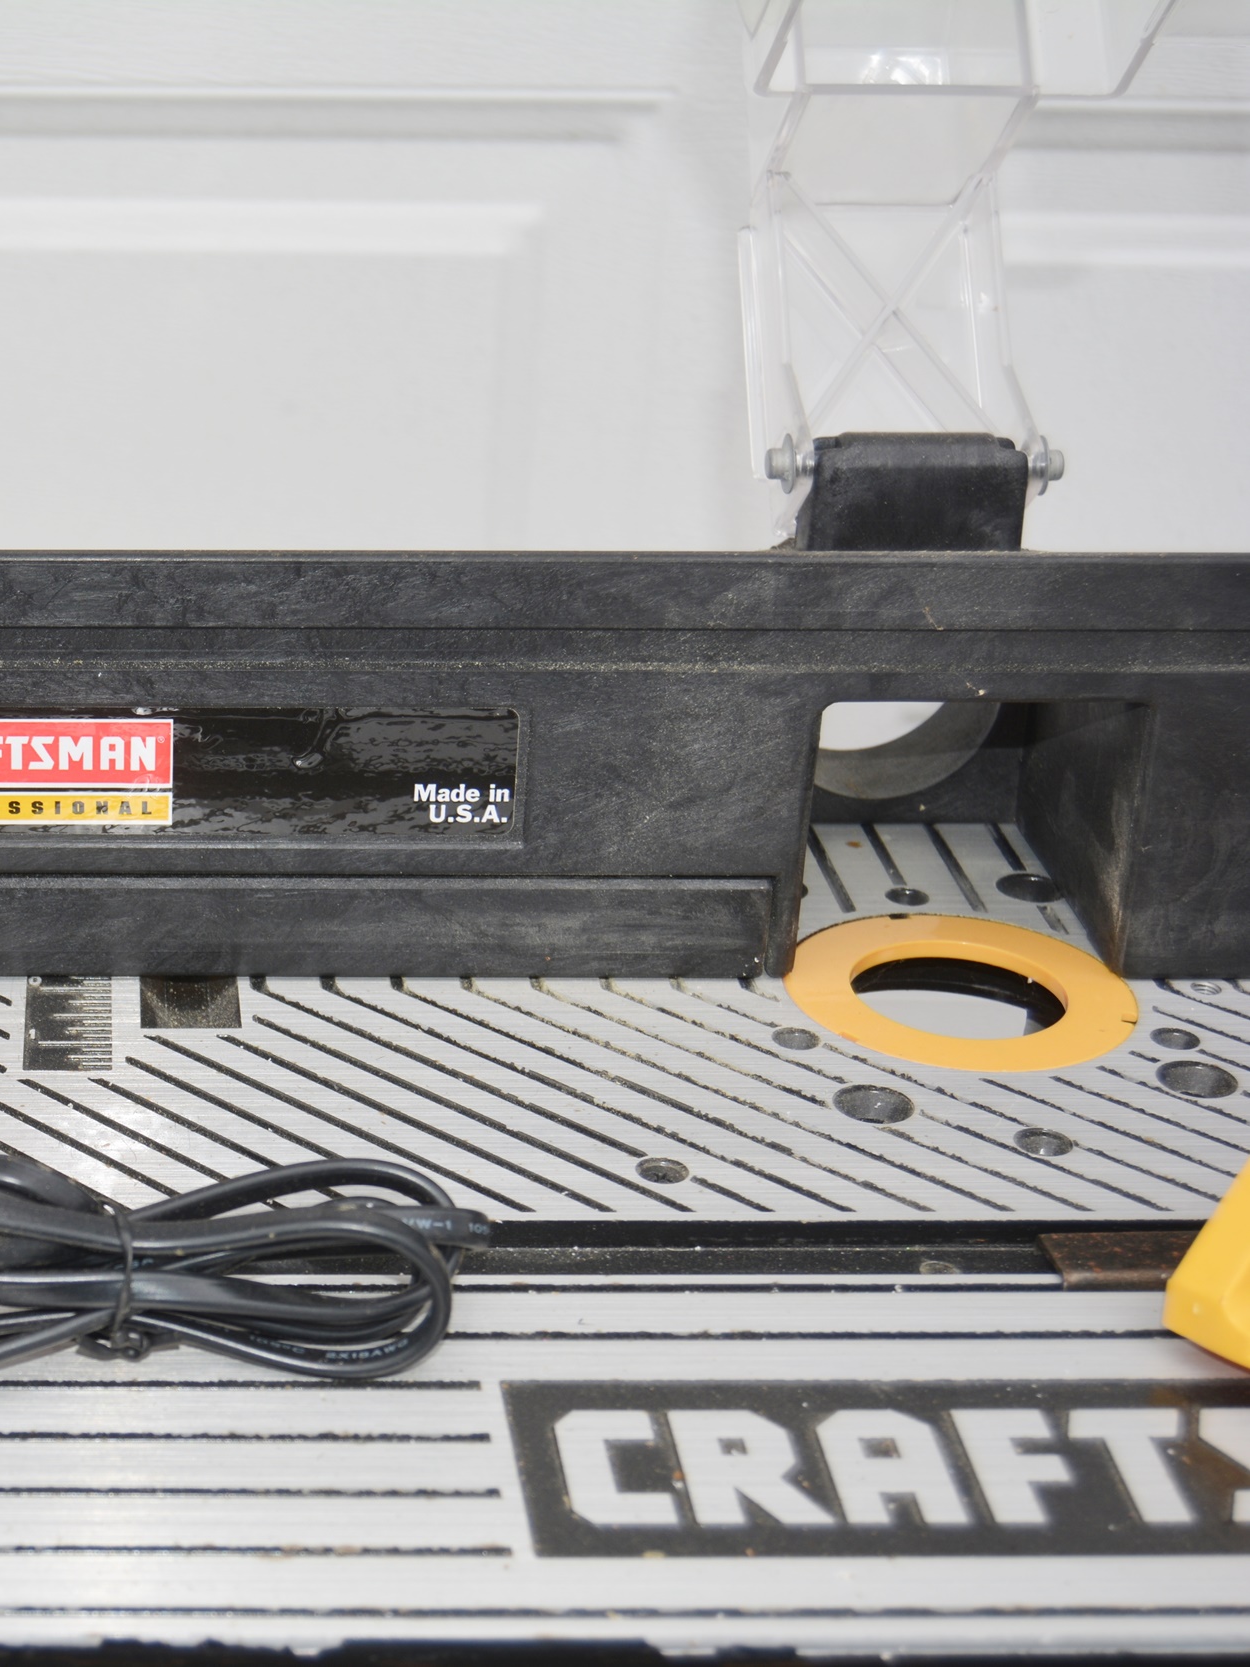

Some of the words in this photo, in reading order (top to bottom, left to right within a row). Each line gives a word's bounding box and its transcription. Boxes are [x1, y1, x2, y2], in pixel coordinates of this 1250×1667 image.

[414, 784, 480, 802] Made
[489, 784, 510, 802] in
[430, 804, 508, 823] U.S.A.
